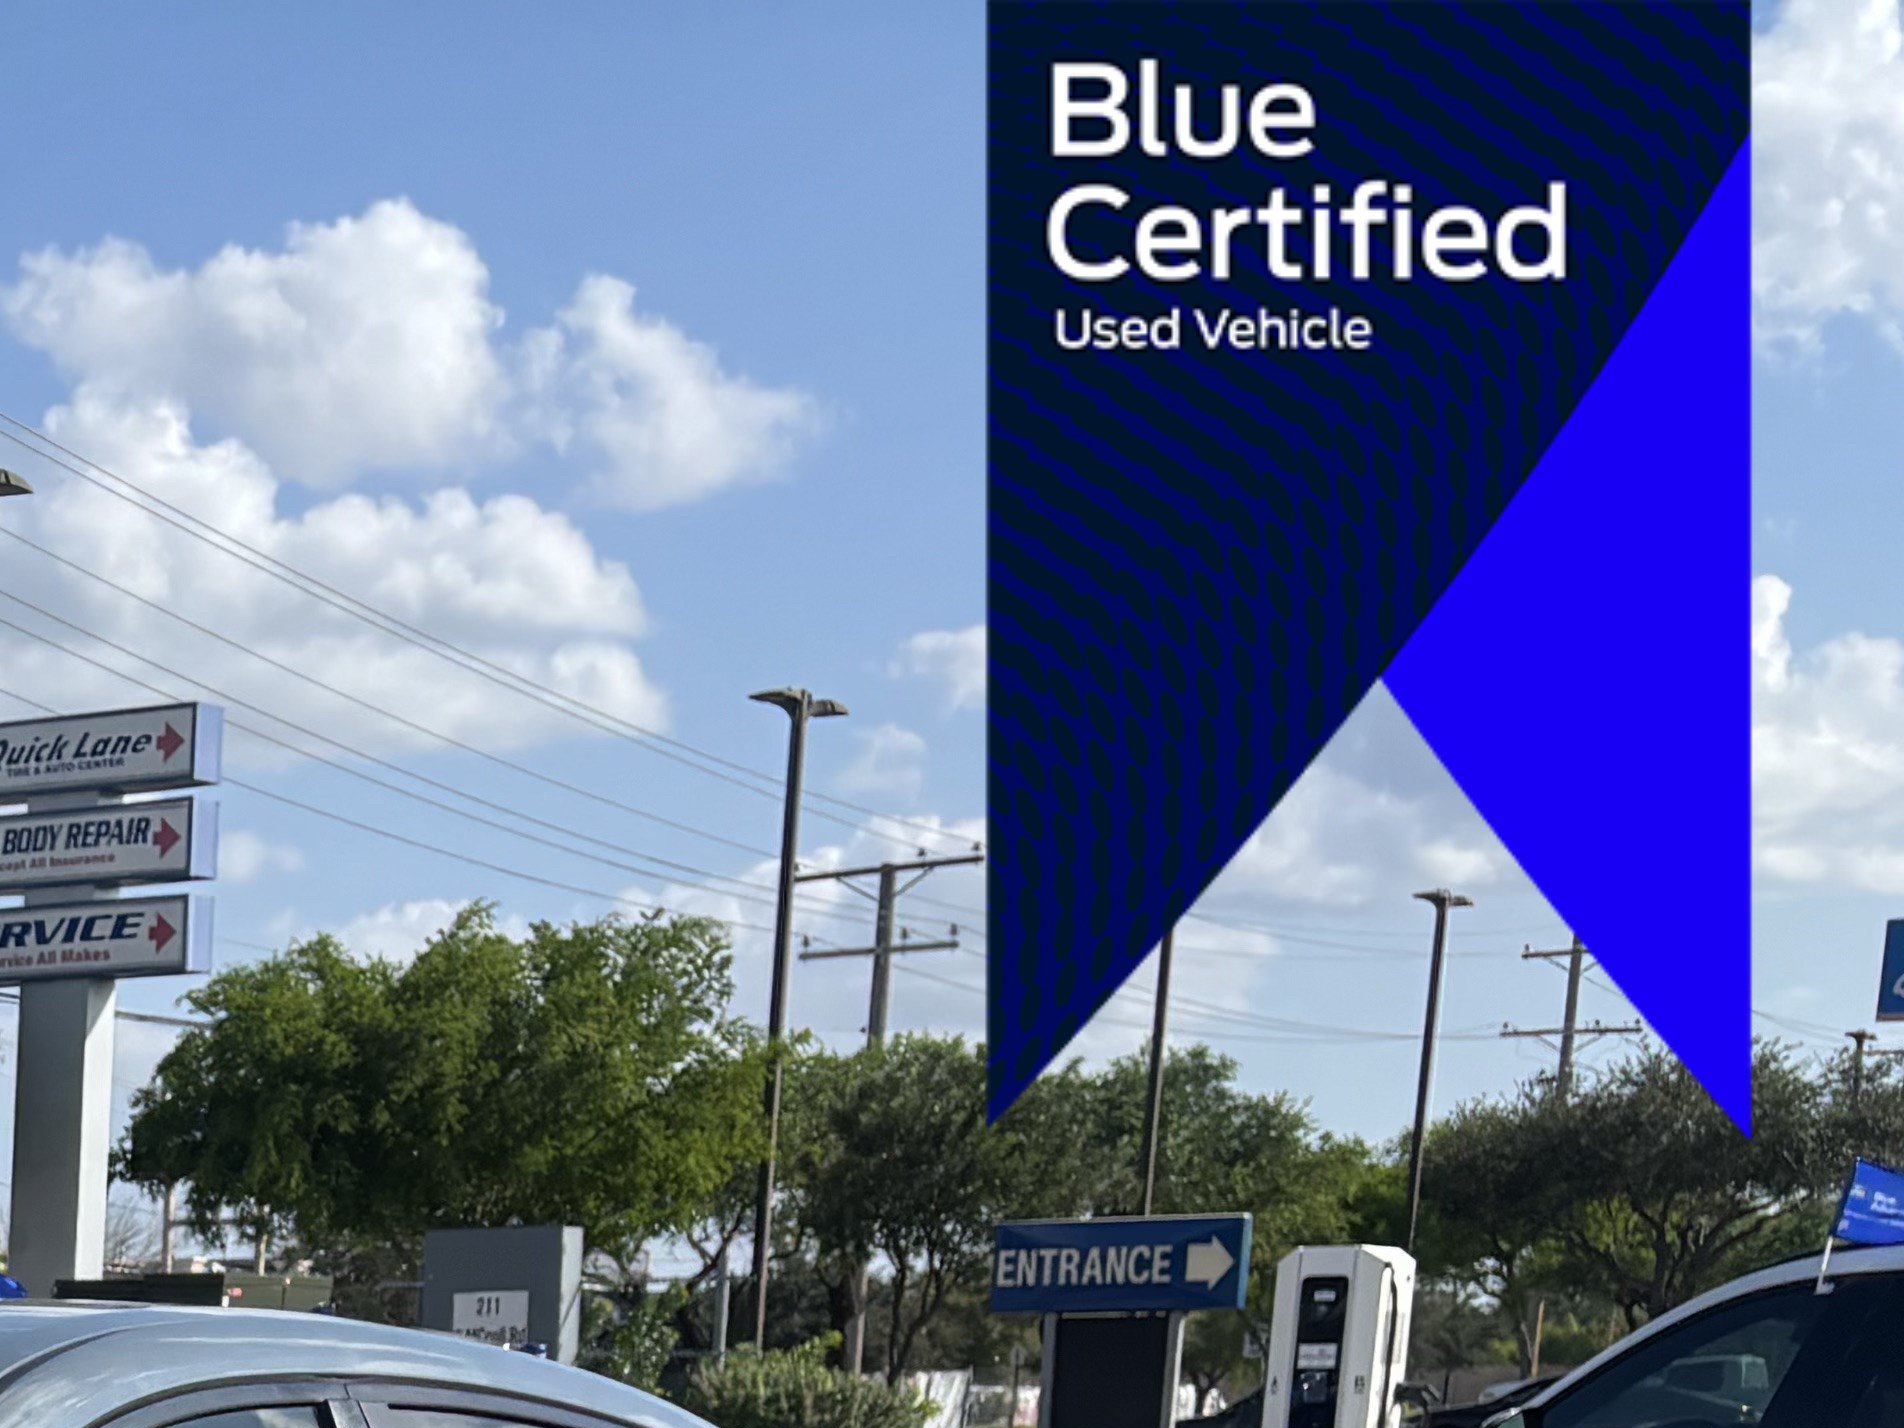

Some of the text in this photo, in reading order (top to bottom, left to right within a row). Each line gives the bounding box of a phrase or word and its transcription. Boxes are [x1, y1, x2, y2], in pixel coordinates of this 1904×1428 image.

[73, 731, 152, 759] Lane
[2, 824, 64, 855] BODY
[65, 816, 152, 850] REPAIR
[996, 1245, 1173, 1287] ENTRANCE
